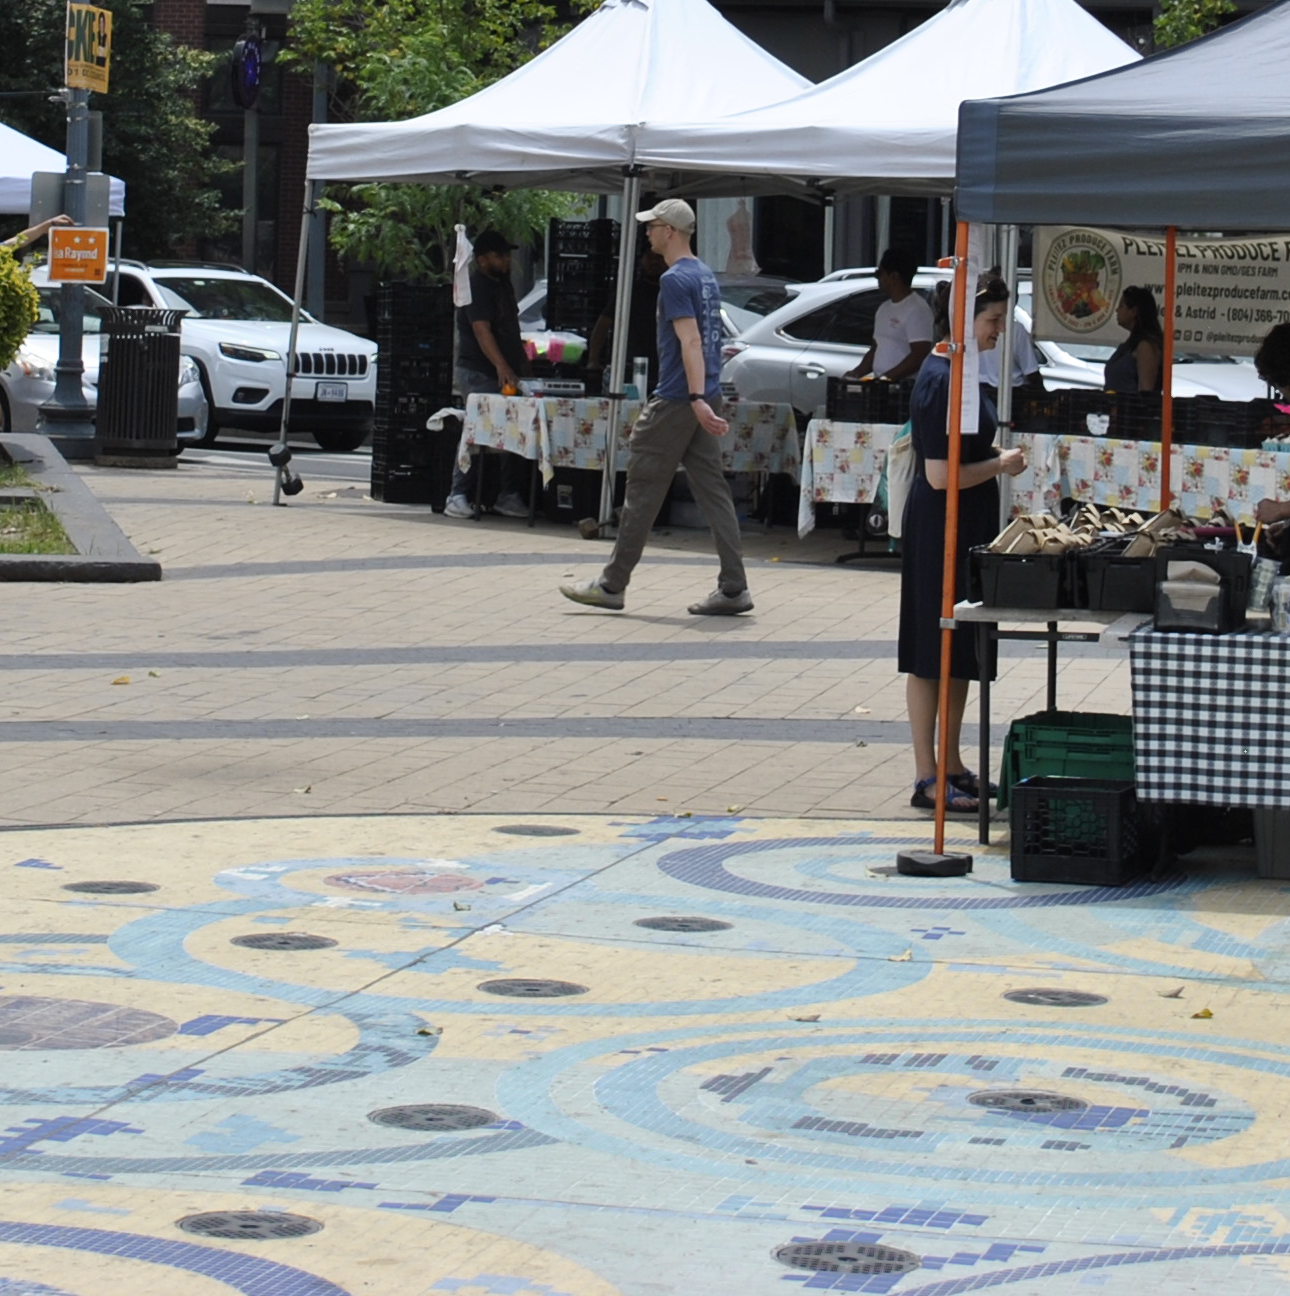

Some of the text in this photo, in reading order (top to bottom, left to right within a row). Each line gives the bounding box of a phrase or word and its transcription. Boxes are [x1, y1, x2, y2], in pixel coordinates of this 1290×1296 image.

[1069, 234, 1107, 252] PRODUCE
[1121, 236, 1196, 258] PLEIEZ
[1196, 243, 1281, 262] PRODUCE
[1178, 263, 1192, 274] IPM
[1194, 264, 1199, 274] &
[1202, 264, 1219, 275] NON
[1258, 266, 1278, 278] FARM
[1185, 306, 1216, 320] Astrid
